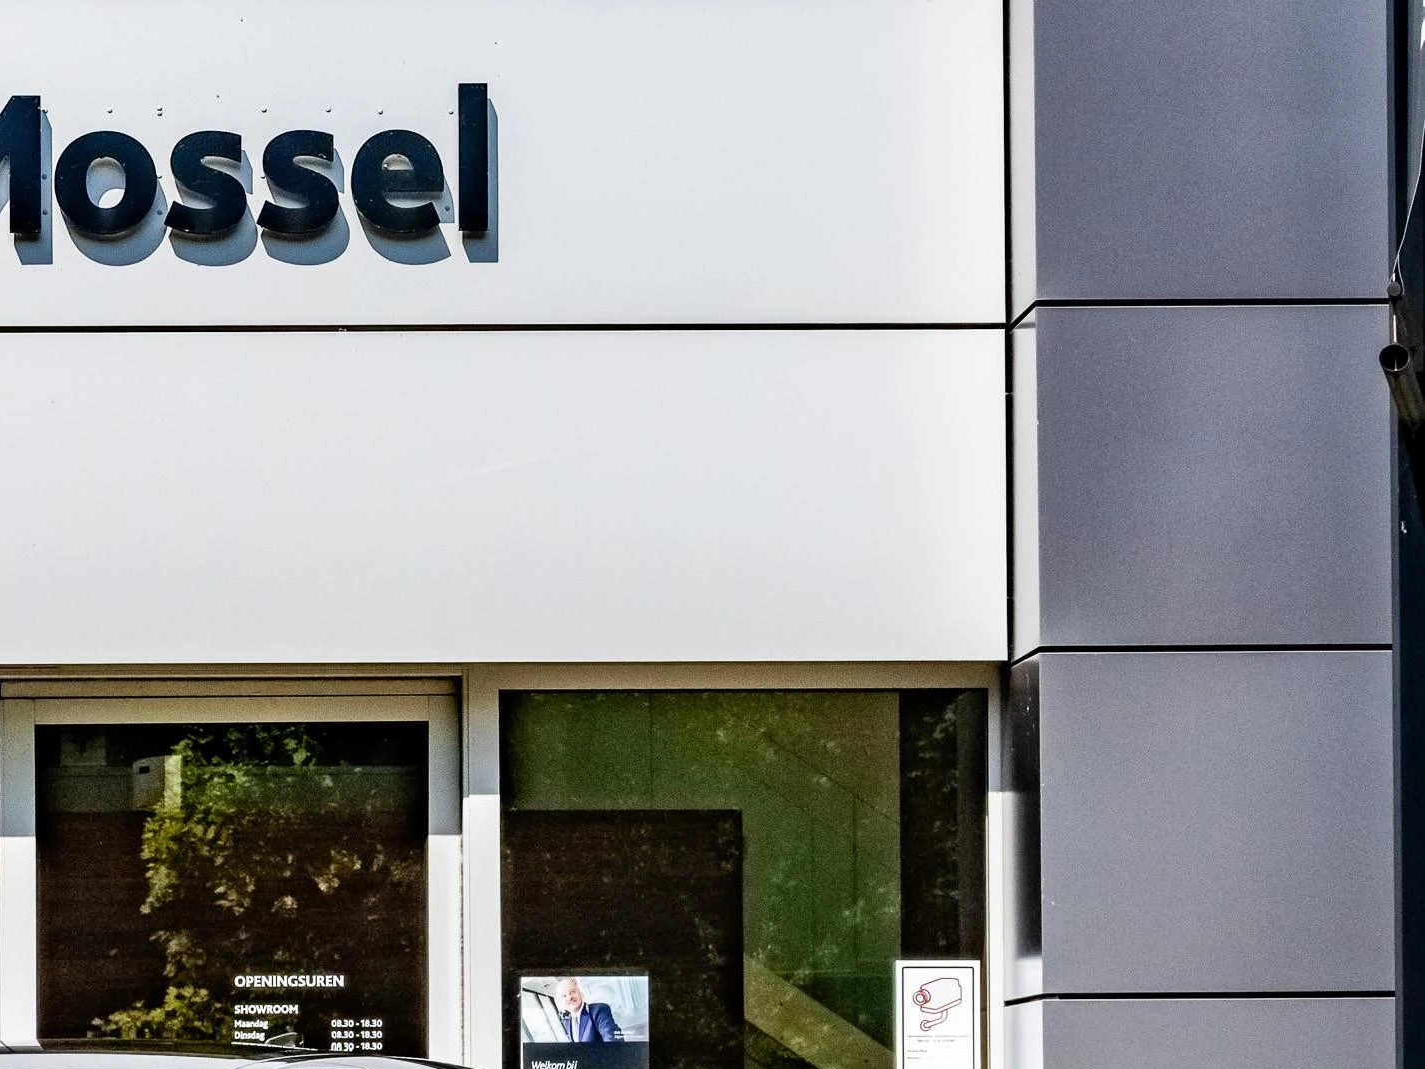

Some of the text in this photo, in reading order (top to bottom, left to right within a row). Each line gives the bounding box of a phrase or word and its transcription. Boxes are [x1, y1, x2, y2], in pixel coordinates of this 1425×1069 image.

[234, 975, 345, 988] OPENINGSUREN
[234, 1004, 299, 1015] SHOWROOM
[234, 1019, 269, 1030] Maandag
[330, 1019, 355, 1028] 08.30
[360, 1019, 383, 1028] 18.30
[234, 1030, 266, 1042] Dinsdag
[330, 1030, 355, 1039] 08.30
[360, 1030, 383, 1039] 18.30
[360, 1041, 383, 1051] 18.30
